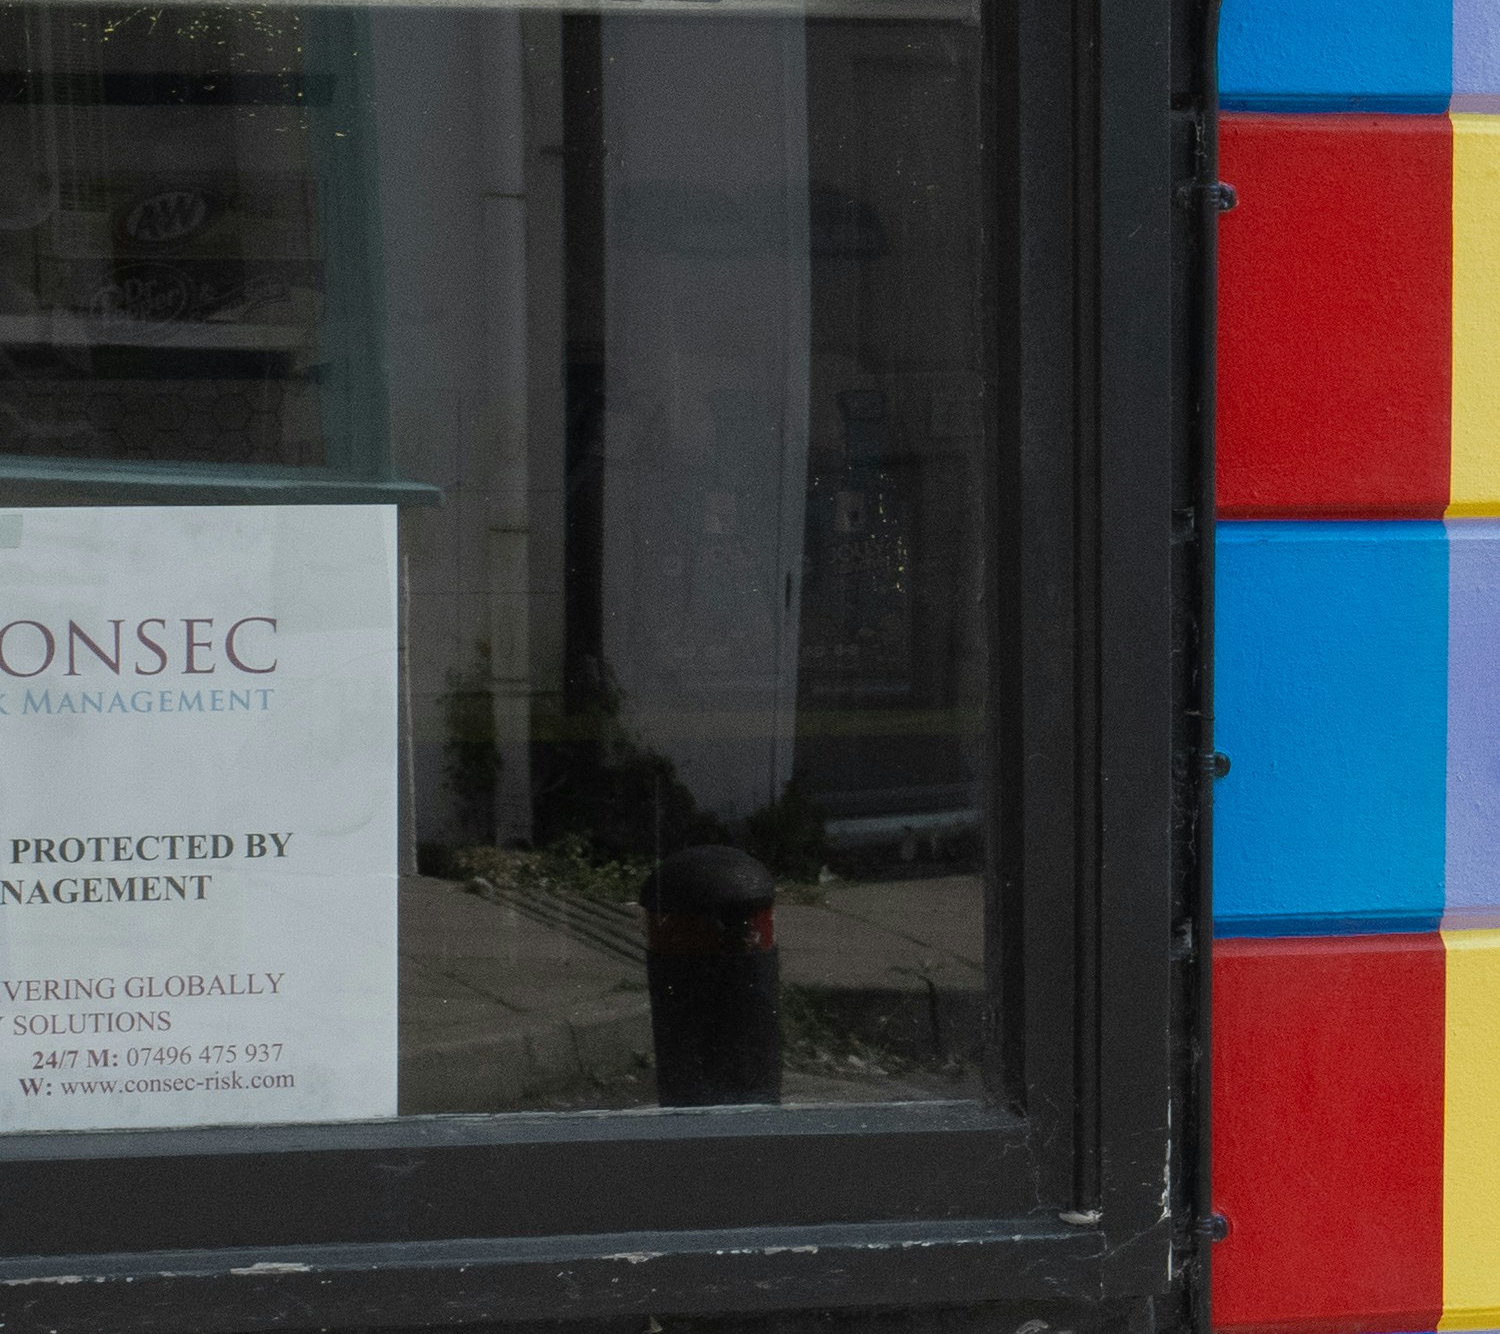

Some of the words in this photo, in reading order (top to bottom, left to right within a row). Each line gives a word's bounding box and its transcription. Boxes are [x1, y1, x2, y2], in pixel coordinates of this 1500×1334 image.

[0, 617, 278, 677] ONSEC
[21, 688, 275, 715] MANAGEMENT
[9, 833, 234, 864] PROTECTED
[244, 832, 294, 859] BY
[0, 875, 213, 905] NAGEMENT
[2, 978, 116, 1002] VERING
[124, 973, 285, 998] GLOBALLY
[13, 1011, 172, 1036] SOLUTIONS
[32, 1050, 79, 1070] 24/7
[86, 1049, 118, 1068] M:
[126, 1047, 193, 1066] 07496
[199, 1045, 239, 1064] 475
[245, 1043, 284, 1062] 937
[18, 1077, 53, 1097] W:
[60, 1071, 295, 1097] www.consec-risk.com
